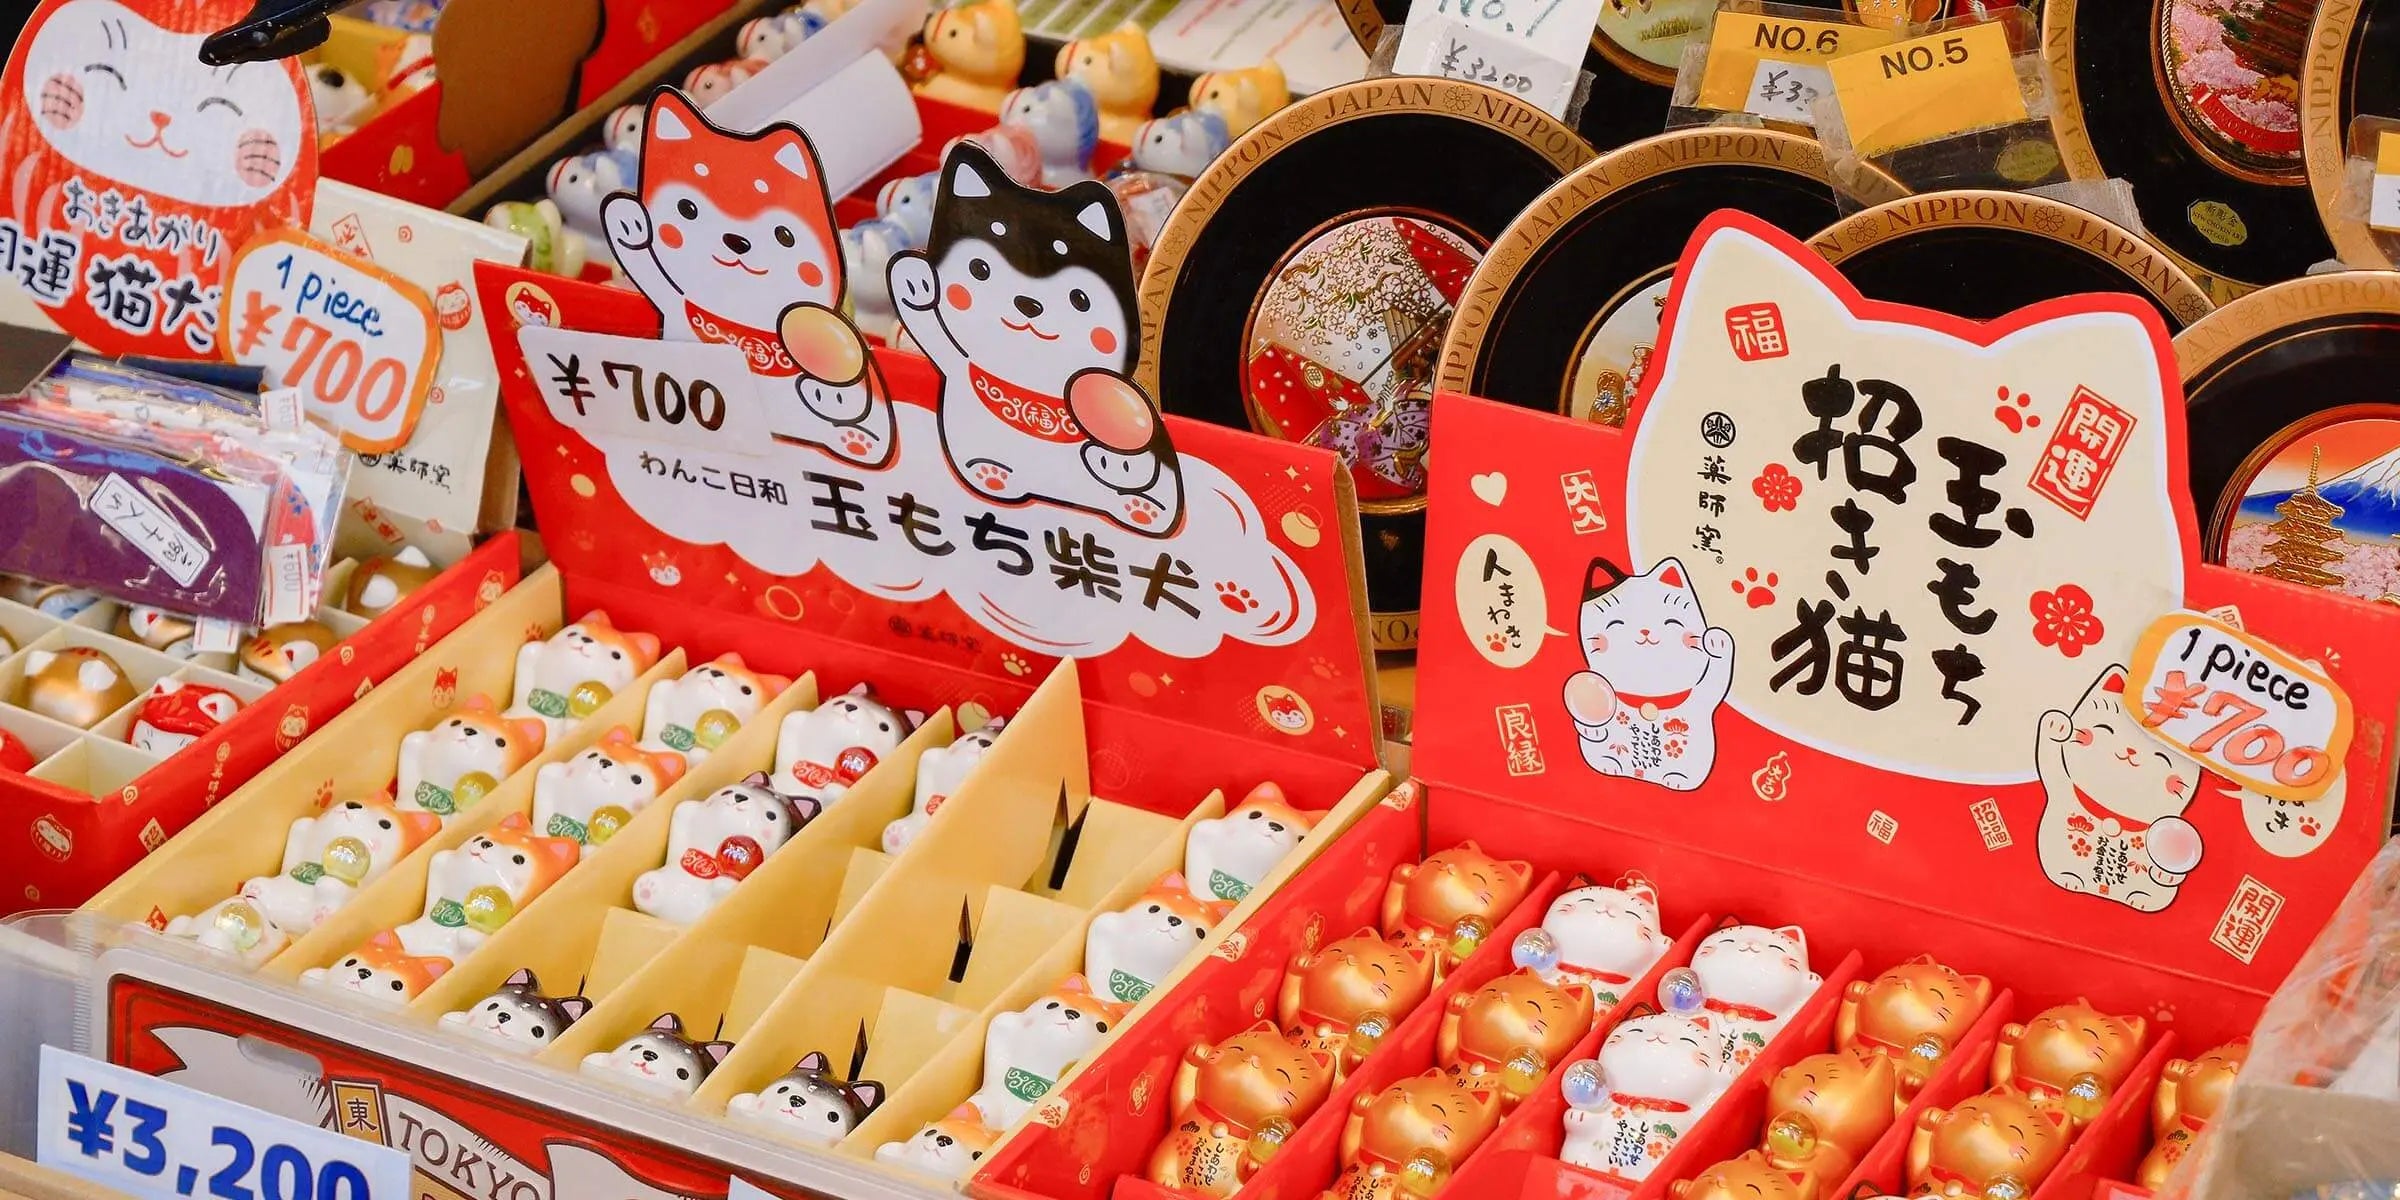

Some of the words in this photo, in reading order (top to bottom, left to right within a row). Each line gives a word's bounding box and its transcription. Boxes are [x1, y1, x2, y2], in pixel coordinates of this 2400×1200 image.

[1441, 38, 1533, 93] ¥3200
[1754, 23, 1840, 55] NO.6
[1880, 38, 1968, 79] NO.5
[1183, 126, 1285, 223] NIPPON
[1324, 83, 1437, 119] JAPAN
[1474, 94, 1594, 168] NIPPON
[67, 181, 218, 263] おきあがり
[1884, 197, 2029, 232] NIPPON
[2070, 218, 2183, 298] JAPAN
[276, 255, 293, 289] 1
[296, 271, 384, 337] piece
[1441, 277, 1500, 395] IPPON
[1516, 166, 1614, 250] JAPAN
[1654, 133, 1788, 167] NIPPON
[238, 290, 407, 423] ¥700
[1731, 309, 1783, 355] 福
[547, 352, 727, 431] ¥700
[638, 450, 788, 506] わんこ日和
[2042, 400, 2117, 504] 開運
[803, 470, 1201, 620] 玉もち柴犬
[1768, 363, 1923, 711] 招き猫
[1483, 548, 1522, 649] 人まねき
[1926, 436, 2035, 727] 玉もち
[2180, 628, 2201, 662] 1
[2200, 643, 2310, 710] piece
[1503, 708, 1543, 774] 良縁
[1650, 722, 1663, 768] しあわせ
[2142, 670, 2331, 788] ¥700
[1868, 813, 1895, 842] 福
[2222, 887, 2277, 954] 開運
[65, 1077, 371, 1200] ¥3,200
[346, 1097, 378, 1133] 東
